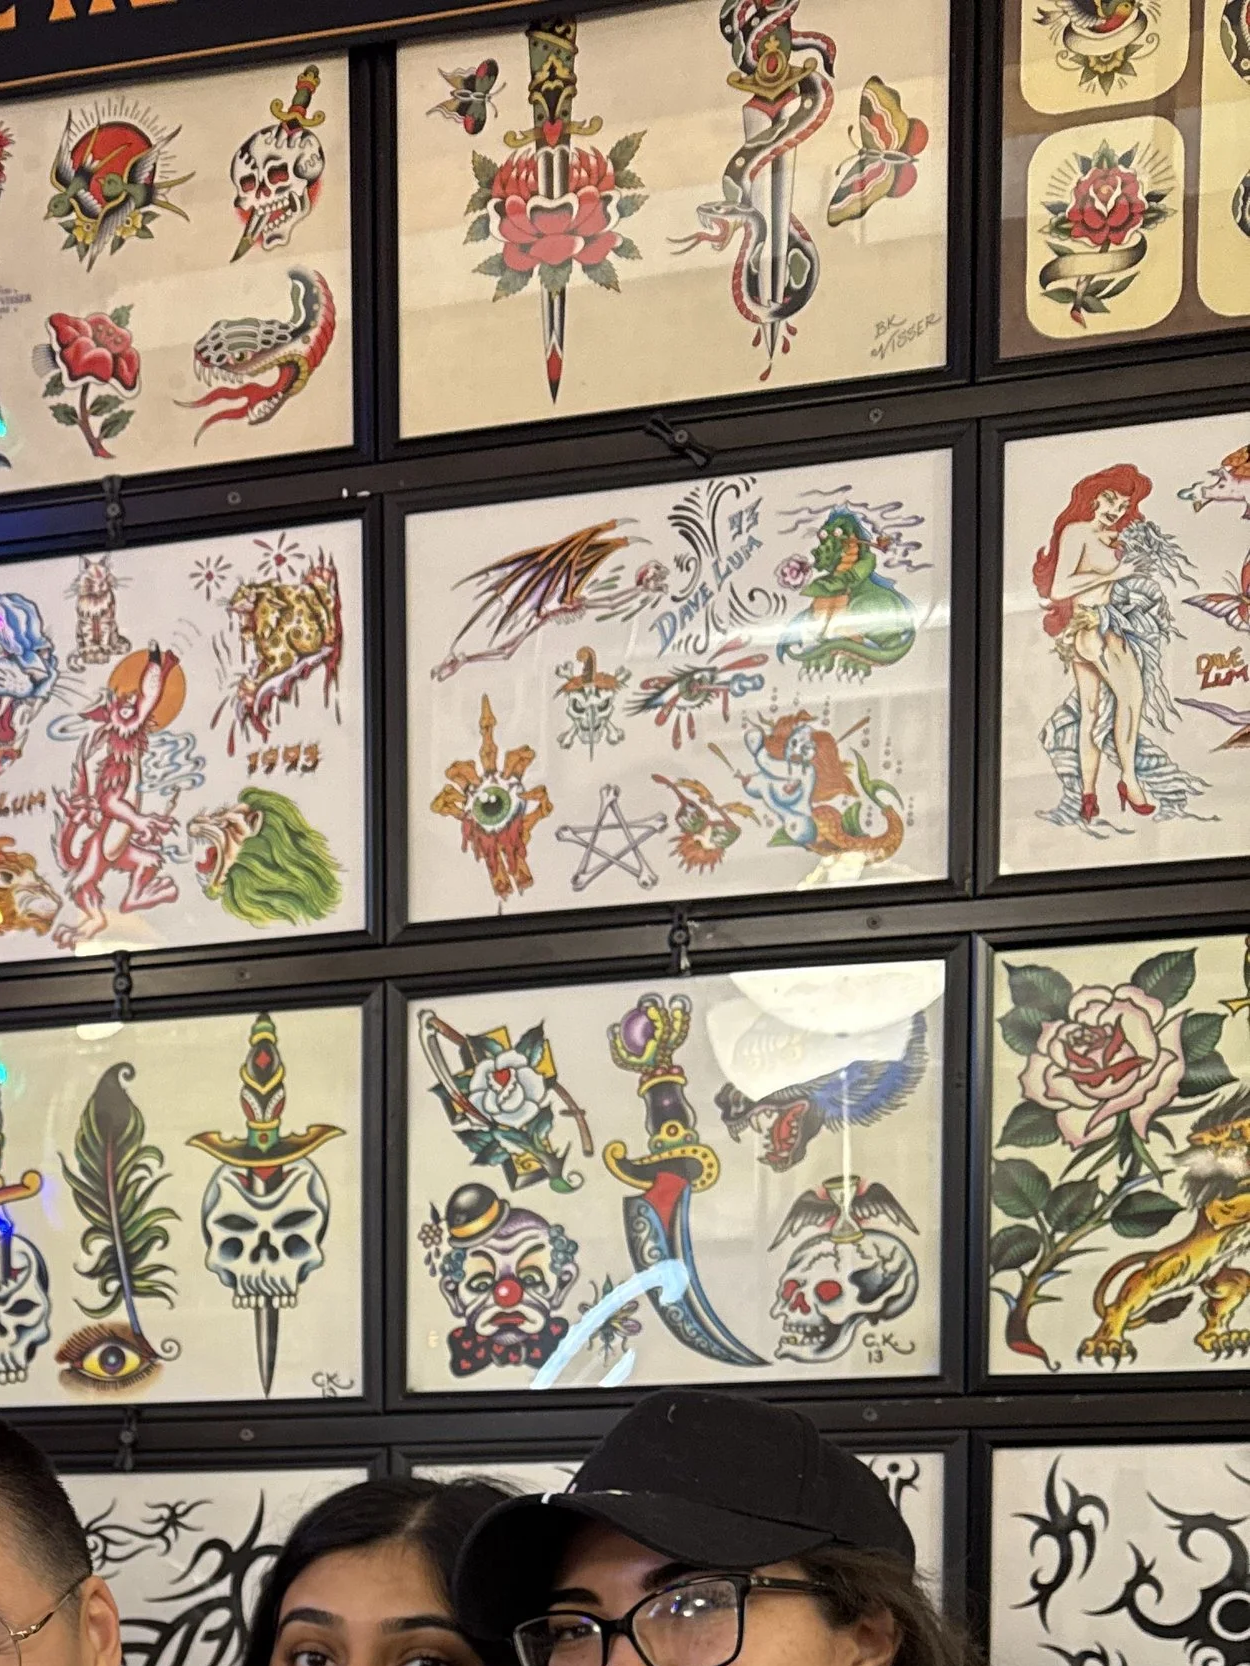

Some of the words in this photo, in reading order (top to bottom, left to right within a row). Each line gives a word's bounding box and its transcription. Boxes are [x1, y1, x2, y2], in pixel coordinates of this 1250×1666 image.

[870, 313, 941, 360] VISSER
[649, 581, 714, 659] DAVE
[712, 534, 763, 592] LUM
[1197, 646, 1244, 675] DAVE
[1200, 664, 1249, 691] LUM
